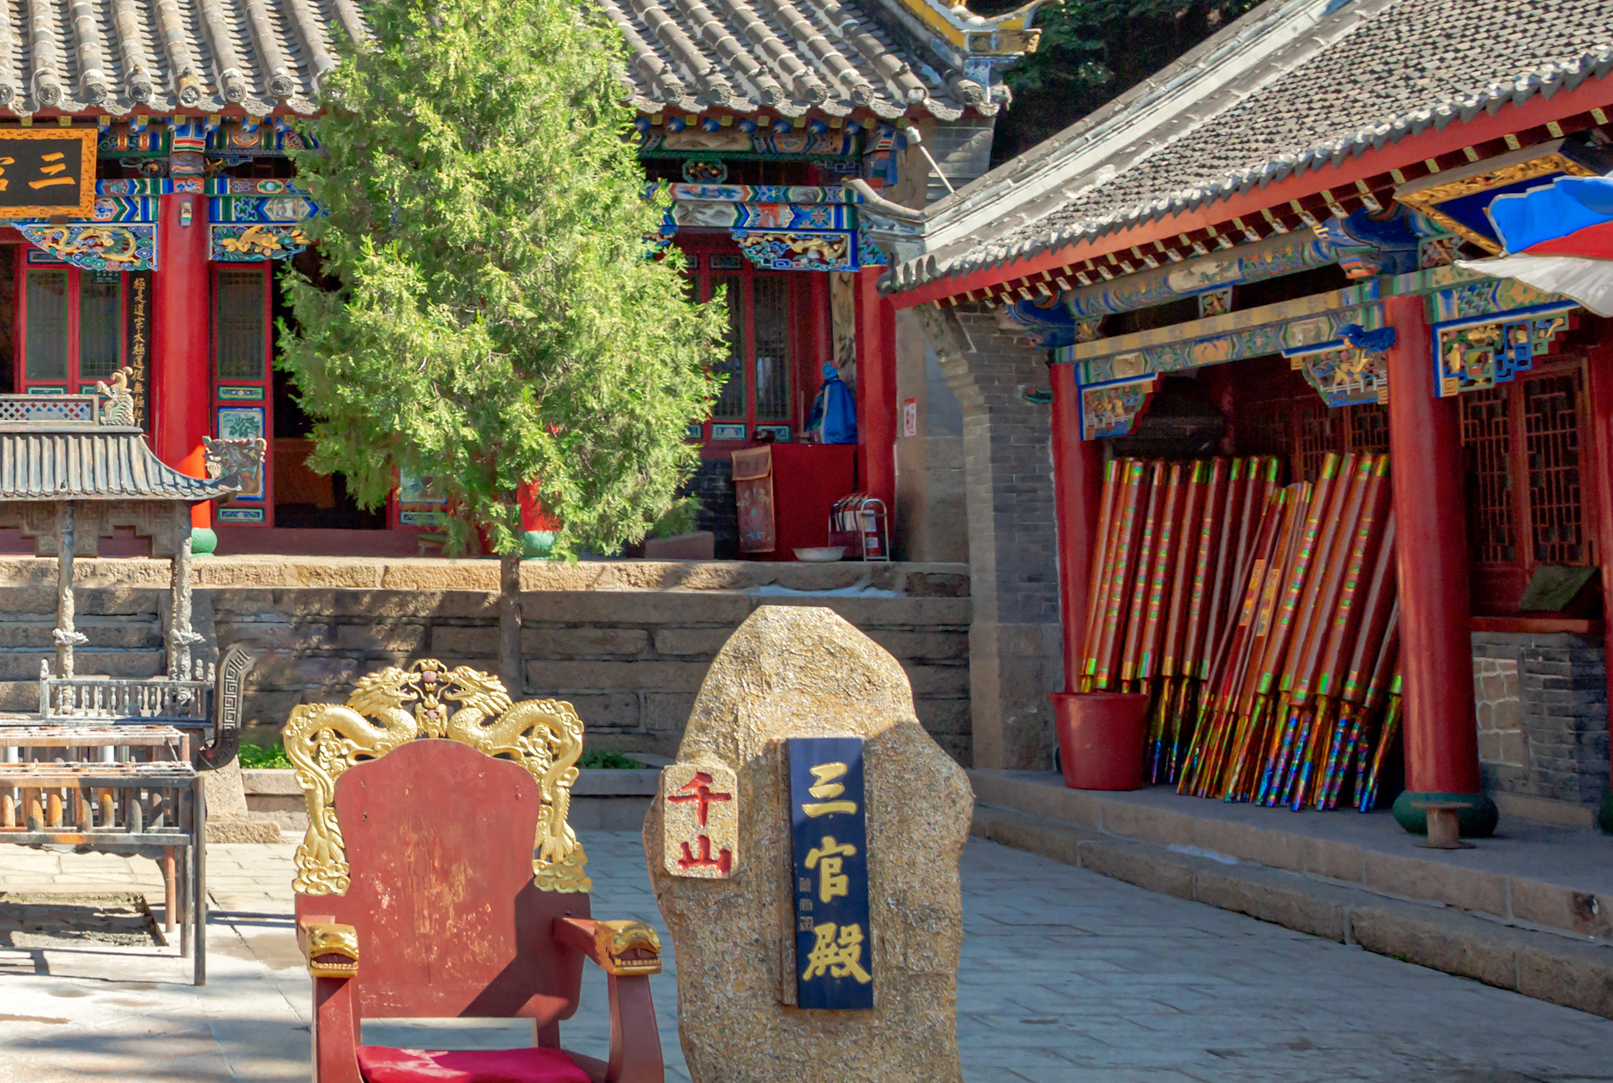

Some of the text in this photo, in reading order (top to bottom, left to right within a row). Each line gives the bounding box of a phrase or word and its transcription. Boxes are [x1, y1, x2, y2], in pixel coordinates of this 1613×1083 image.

[668, 771, 732, 875] 千山
[801, 761, 872, 984] 三官殿
